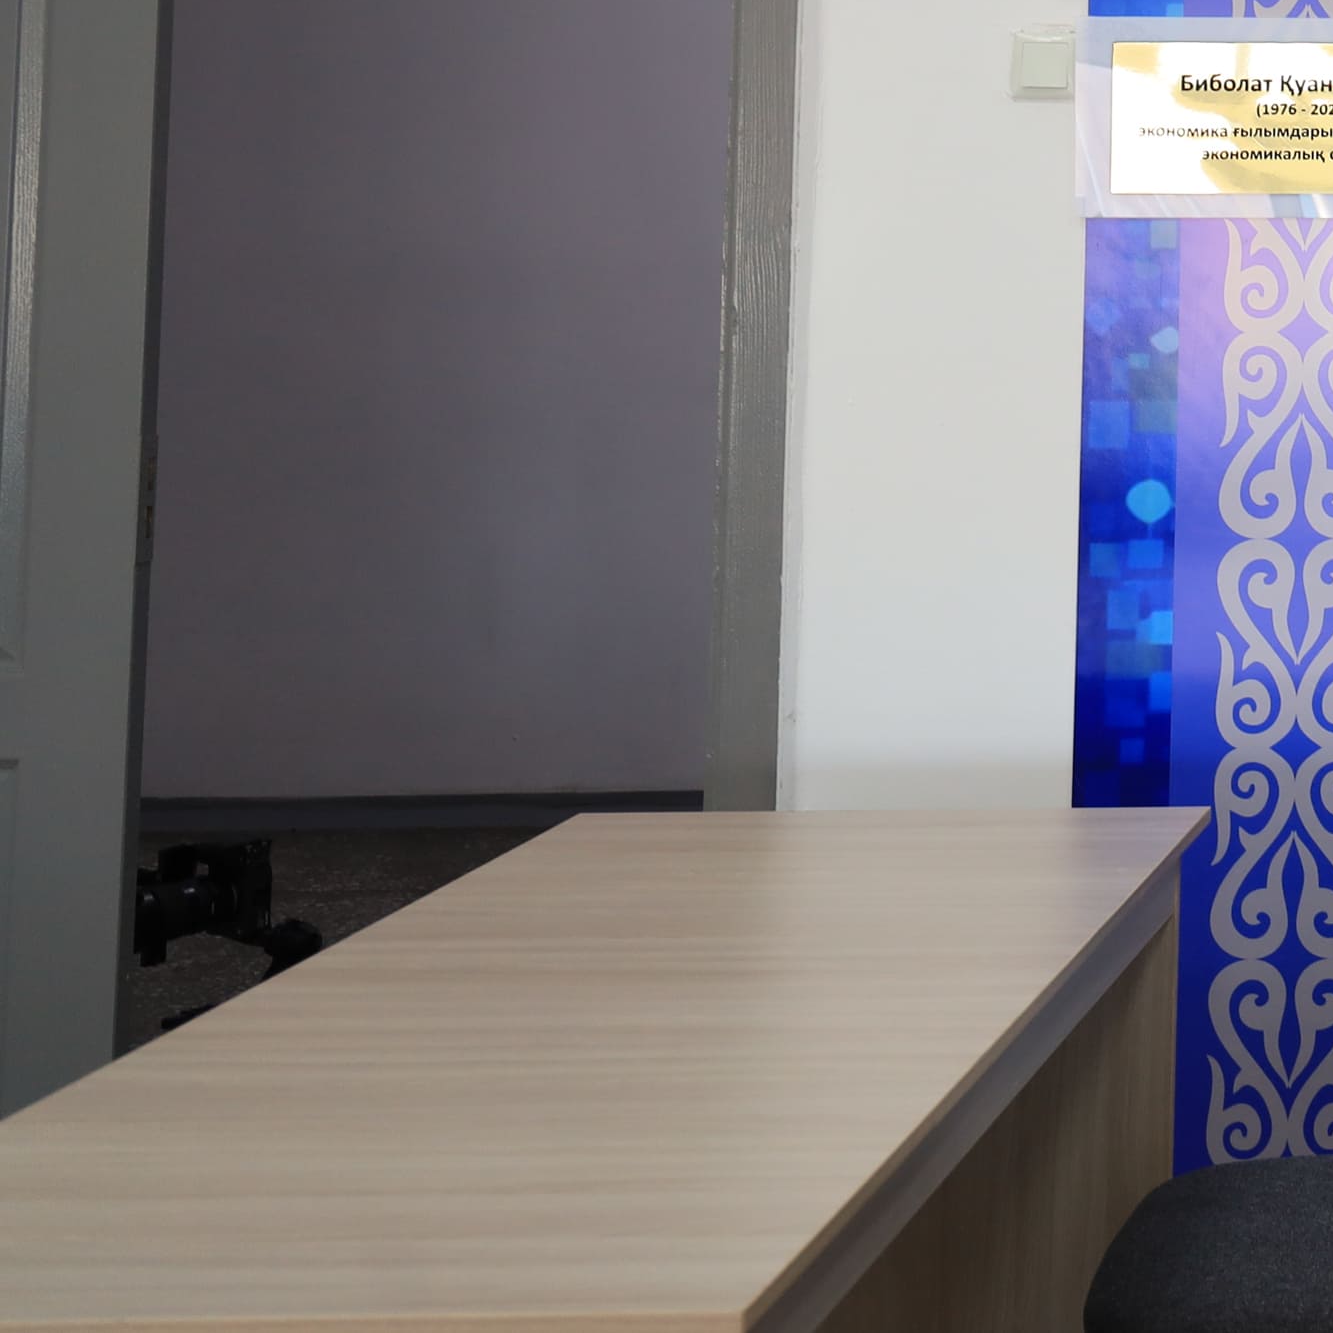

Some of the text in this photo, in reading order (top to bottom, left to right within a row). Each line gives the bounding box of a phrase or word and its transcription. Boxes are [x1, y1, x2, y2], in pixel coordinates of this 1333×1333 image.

[1180, 73, 1273, 93] Биболат
[1256, 102, 1297, 118] (1976
[1138, 126, 1228, 138] экономика
[1202, 148, 1325, 163] экономикалық
